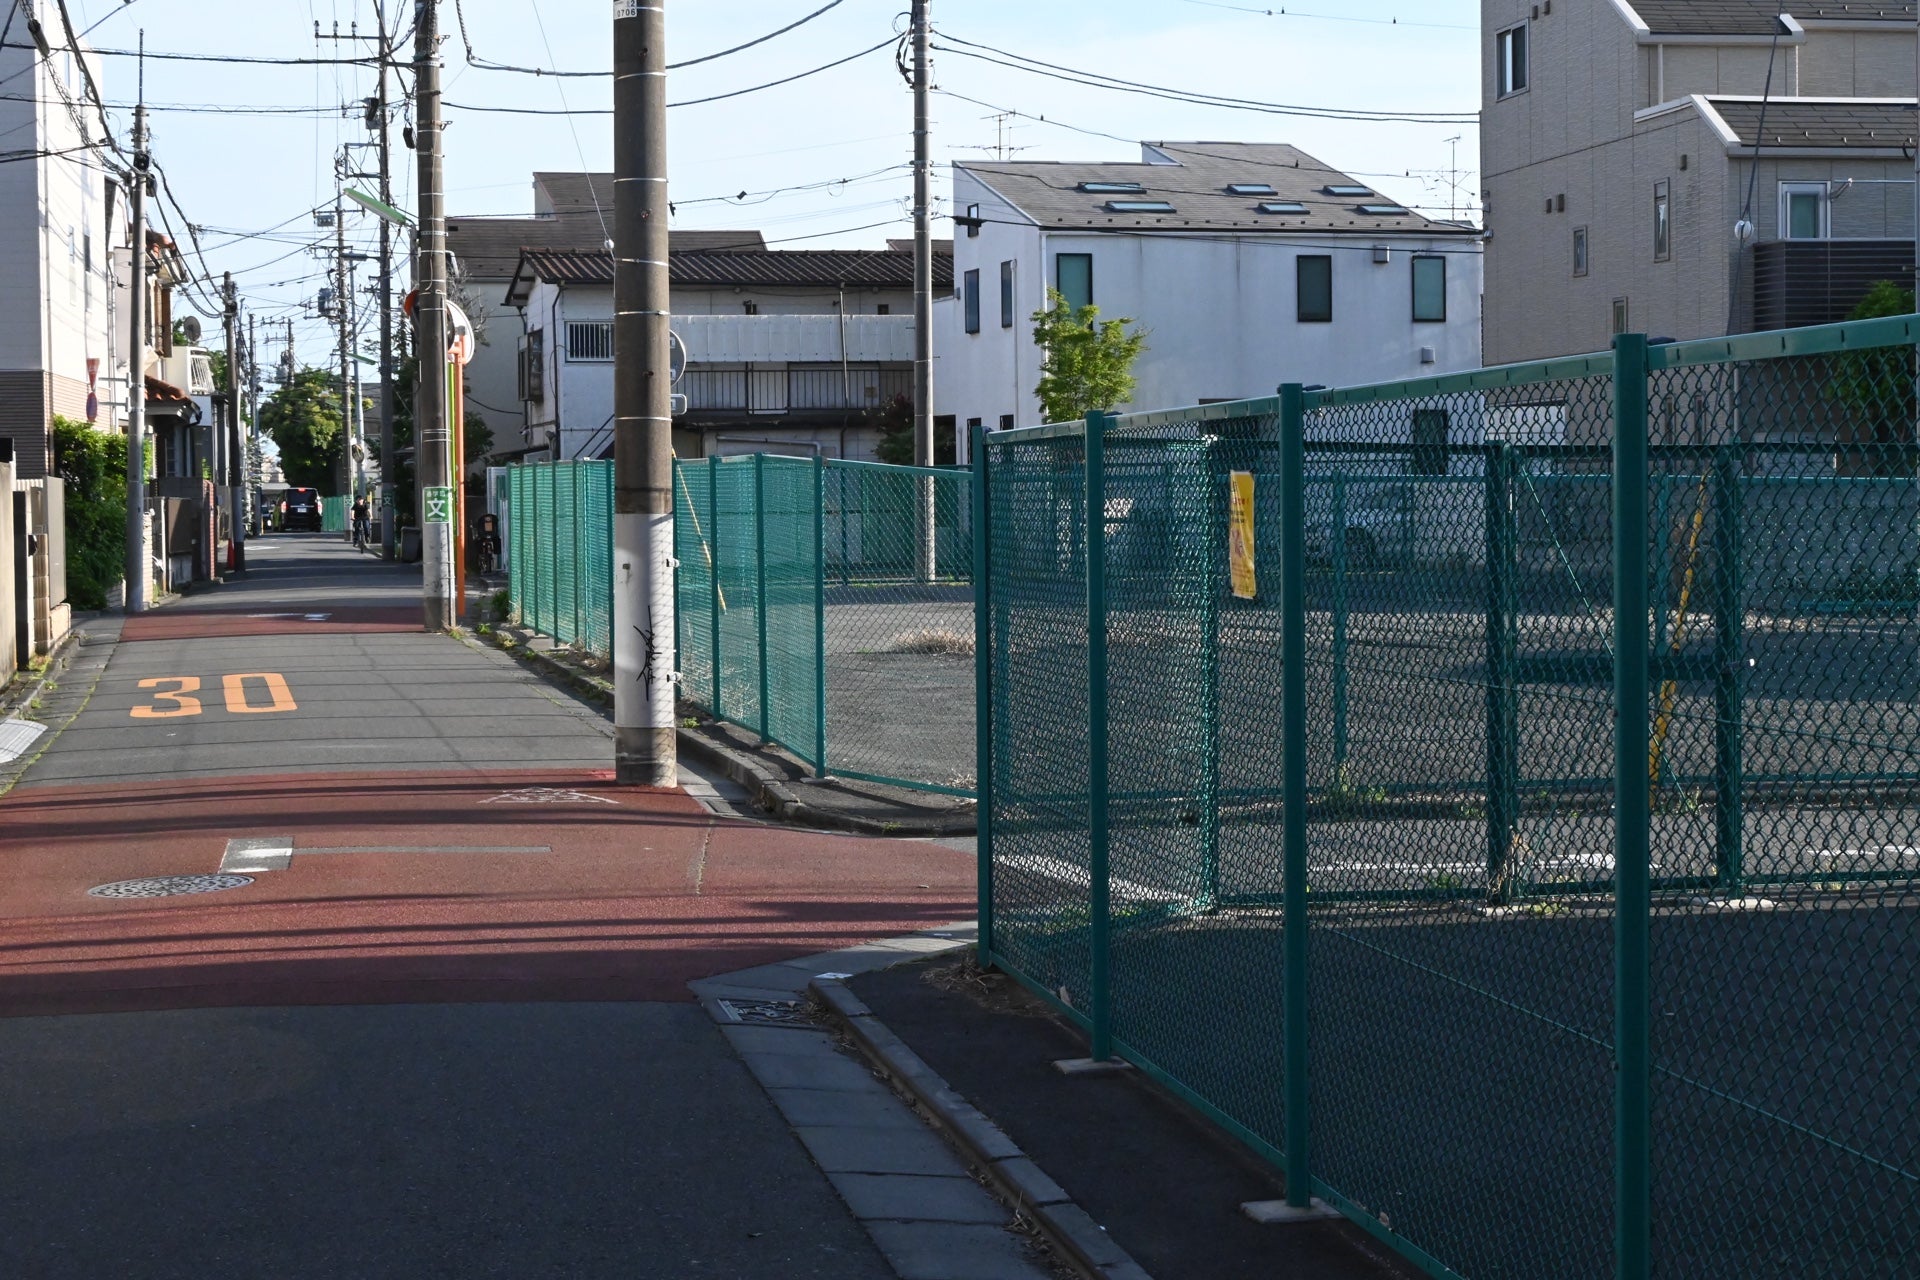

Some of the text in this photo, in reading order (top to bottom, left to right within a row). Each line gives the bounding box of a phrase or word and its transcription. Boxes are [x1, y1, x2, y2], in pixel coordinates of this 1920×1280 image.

[616, 8, 636, 17] 0706
[427, 497, 446, 517] 文
[129, 672, 298, 718] 30
